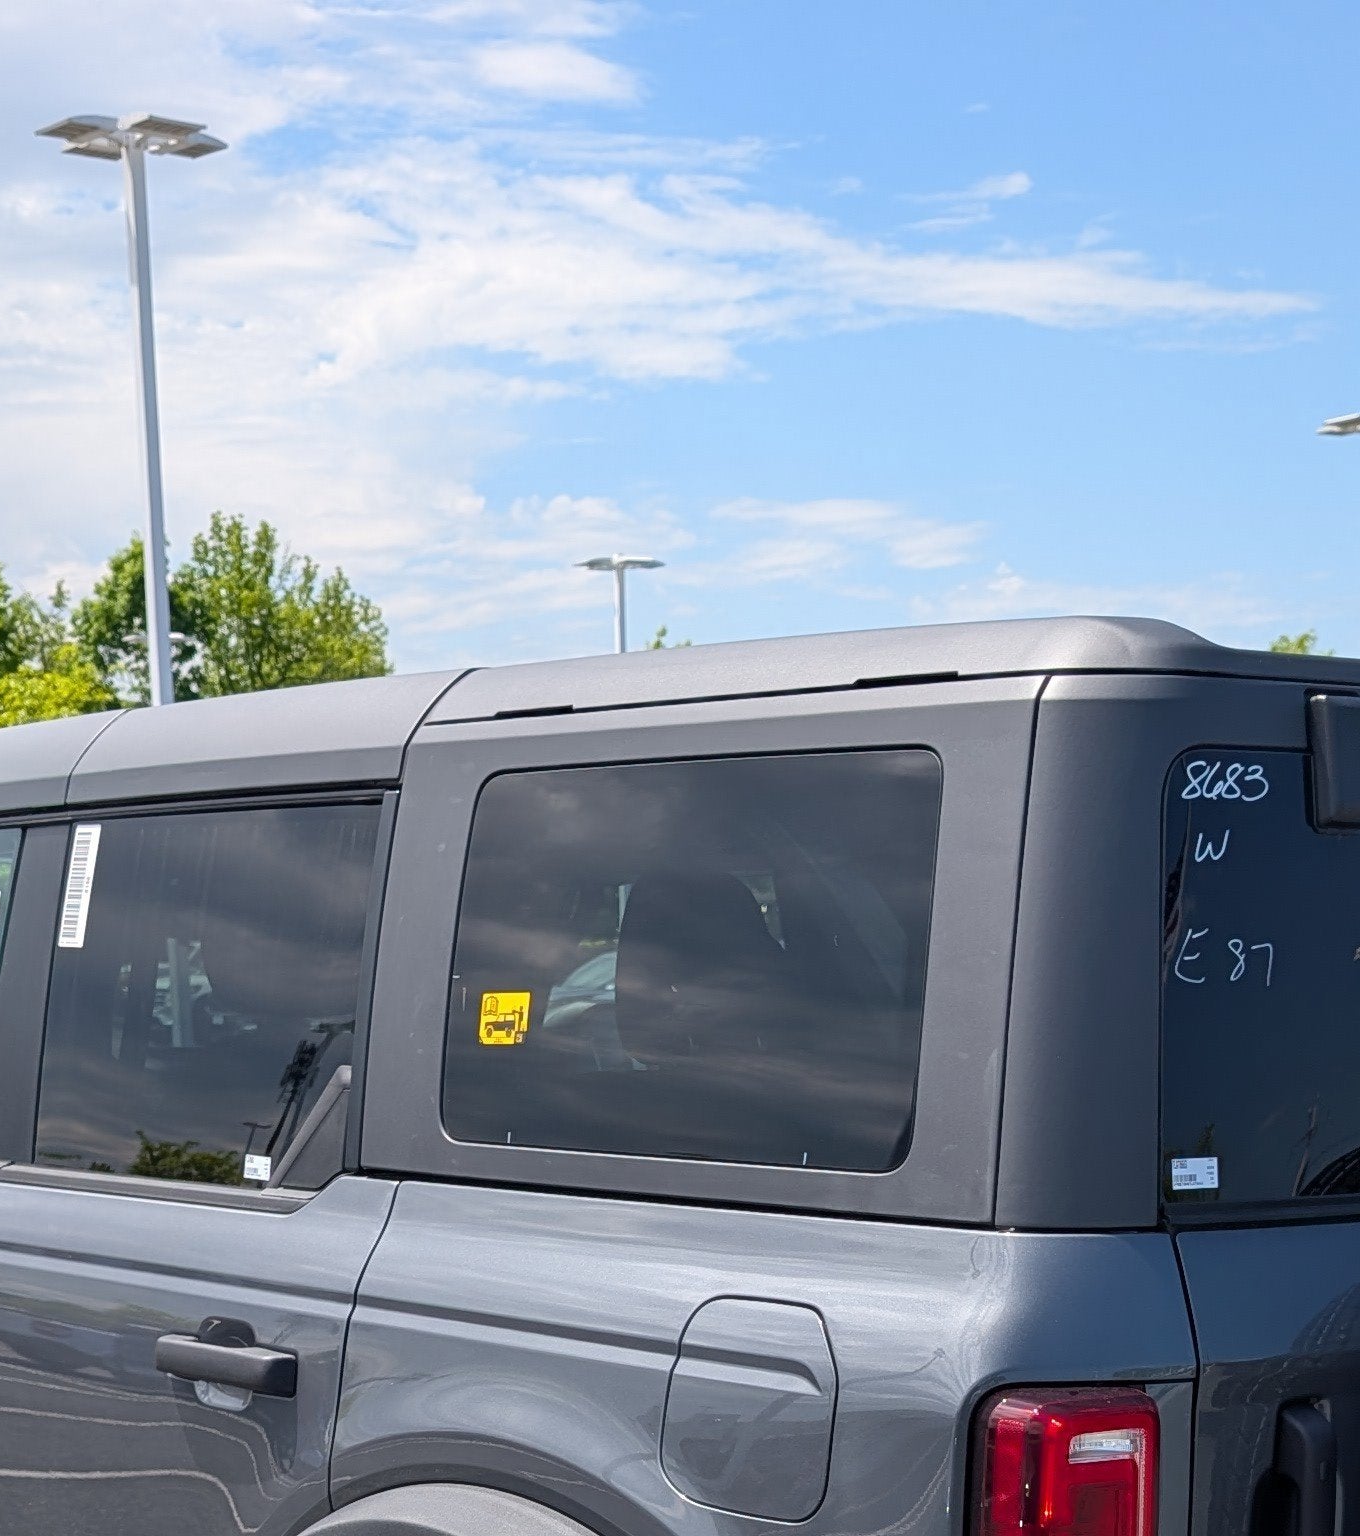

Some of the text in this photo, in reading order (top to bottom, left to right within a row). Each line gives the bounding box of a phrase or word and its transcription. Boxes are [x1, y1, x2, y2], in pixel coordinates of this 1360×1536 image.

[1181, 760, 1269, 801] 8683
[1194, 829, 1230, 862] W
[1174, 927, 1274, 987] E 87
